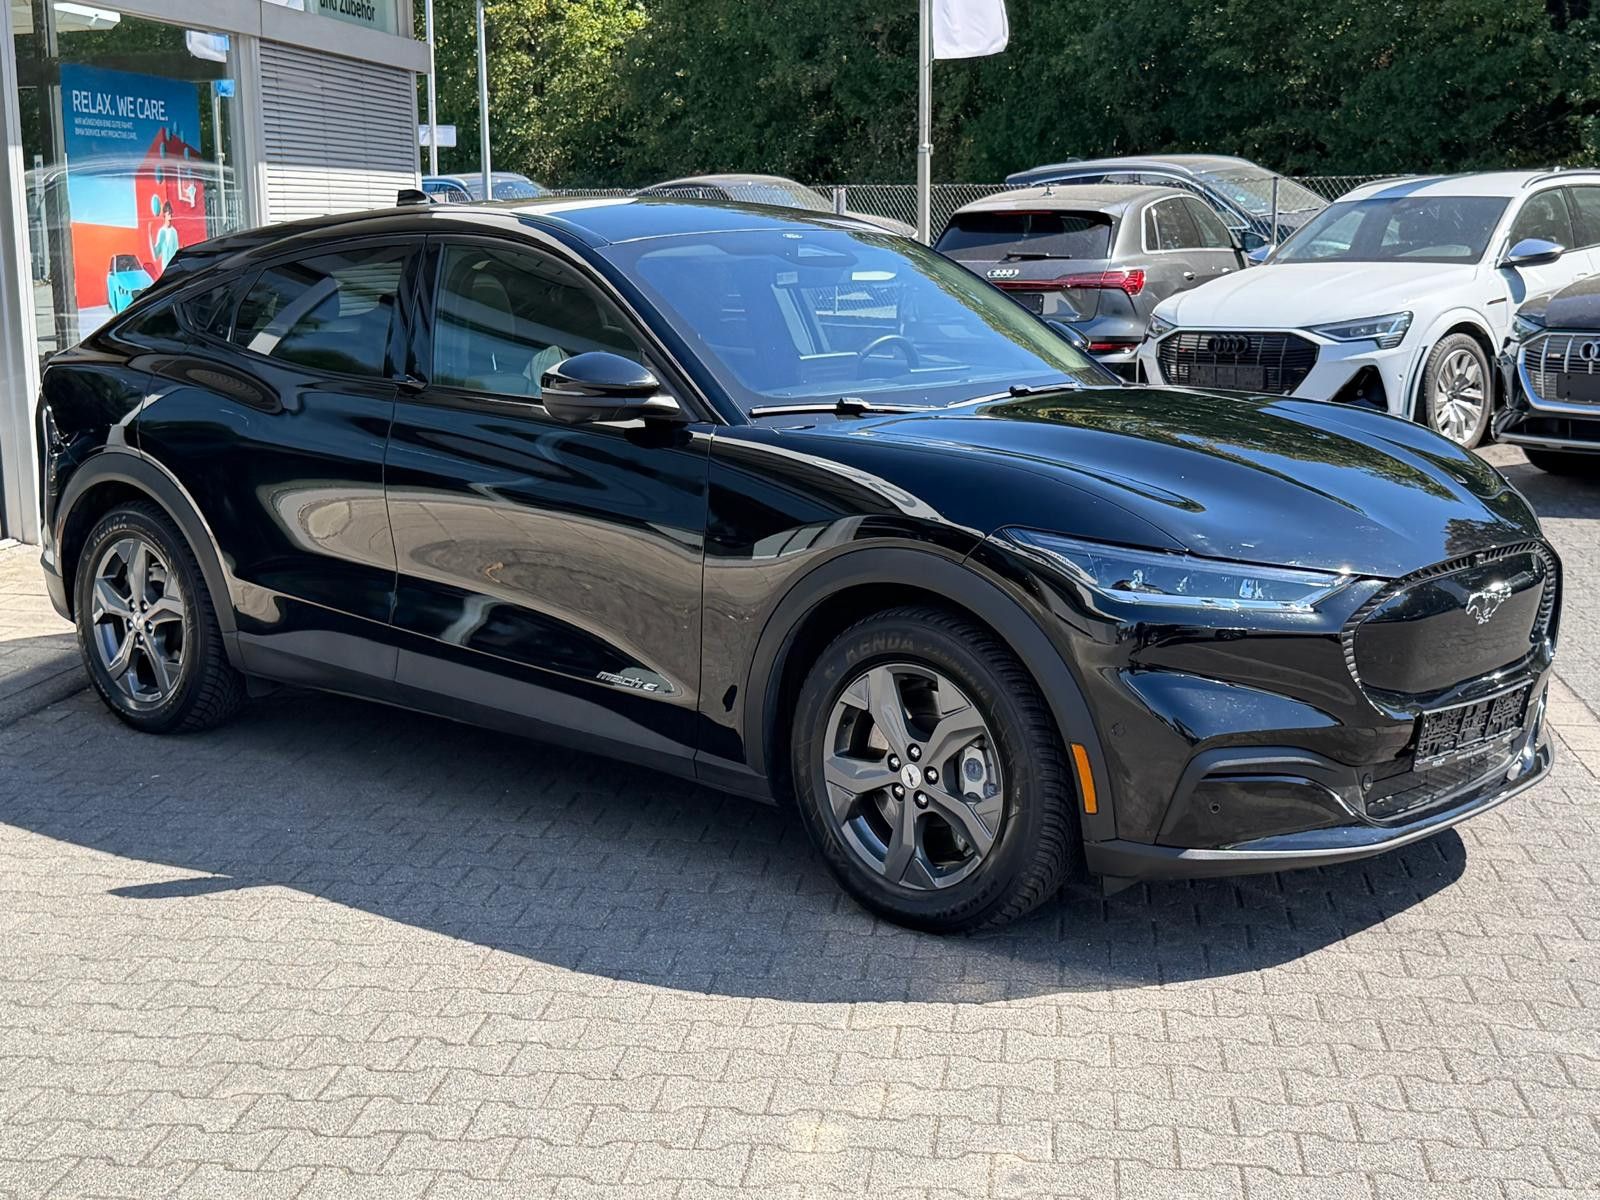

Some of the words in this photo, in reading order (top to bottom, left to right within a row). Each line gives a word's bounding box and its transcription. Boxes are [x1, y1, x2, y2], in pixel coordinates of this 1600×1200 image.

[340, 0, 375, 21] Zubehör
[72, 90, 115, 116] RELAX.
[116, 94, 135, 118] WE
[136, 97, 169, 121] CARE.
